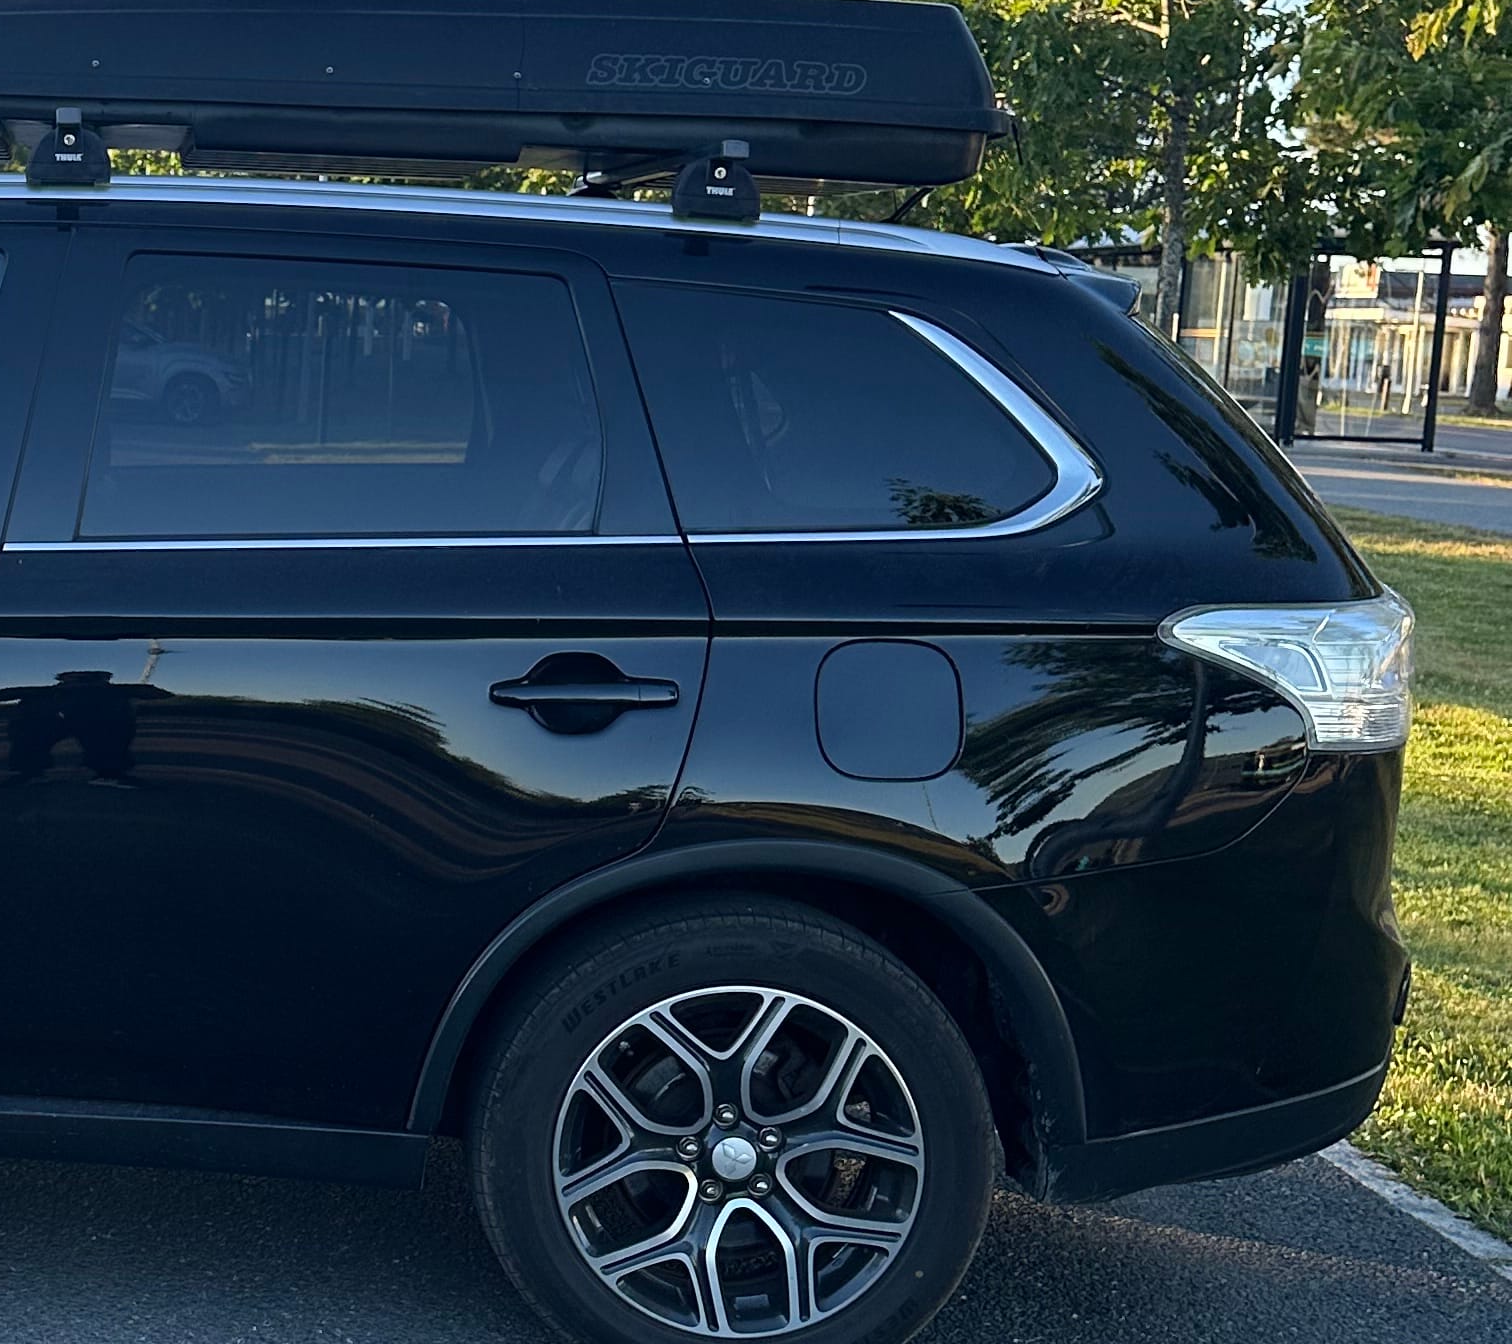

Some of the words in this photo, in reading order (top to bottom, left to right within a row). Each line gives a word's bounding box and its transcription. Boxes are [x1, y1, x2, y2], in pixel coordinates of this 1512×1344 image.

[588, 54, 867, 95] SKIGUARD
[55, 153, 83, 162] THULE
[706, 186, 735, 196] THULE
[561, 950, 681, 1034] WESTLAKE
